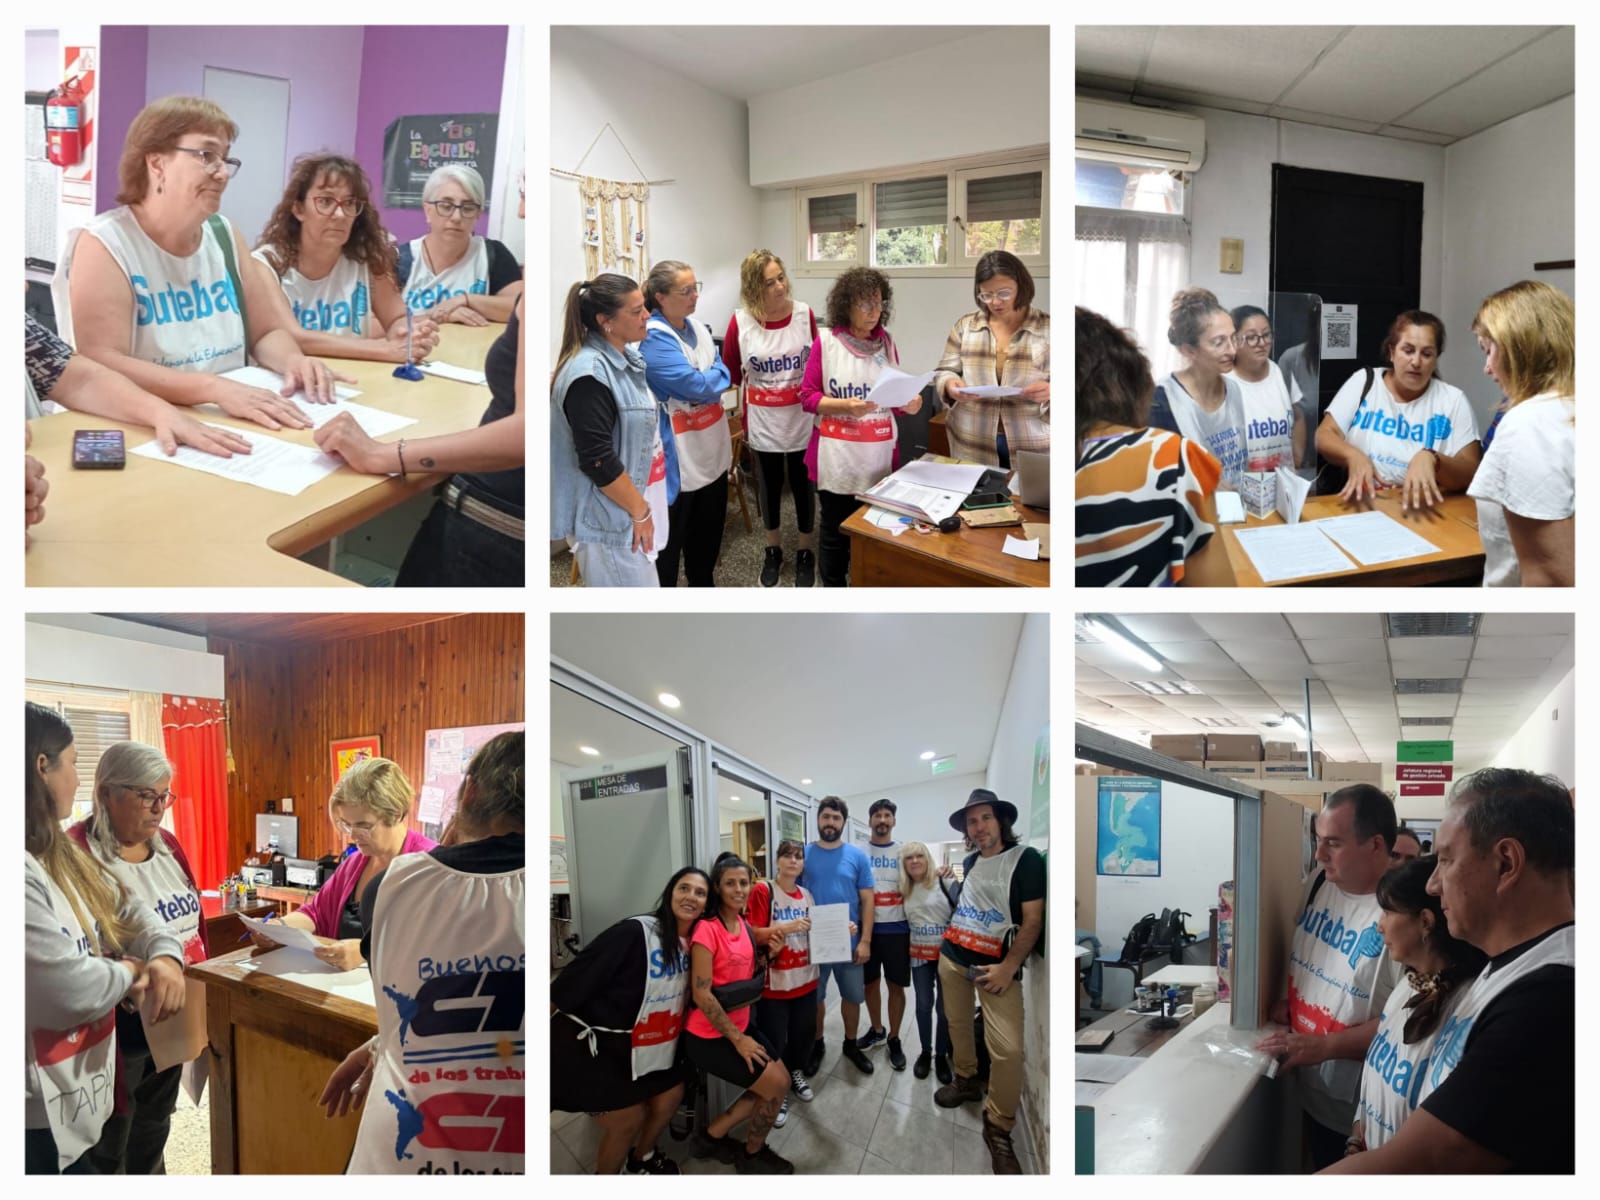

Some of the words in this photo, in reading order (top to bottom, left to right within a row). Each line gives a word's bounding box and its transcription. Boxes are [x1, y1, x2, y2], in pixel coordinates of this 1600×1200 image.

[131, 274, 232, 327] Suteba
[749, 354, 802, 374] Suteba
[598, 775, 617, 786] MESA
[617, 773, 627, 783] DE
[598, 782, 640, 799] ENTRADAS
[154, 893, 198, 923] teba
[408, 1070, 431, 1084] de
[435, 1067, 469, 1082] los
[473, 1066, 525, 1081] trab
